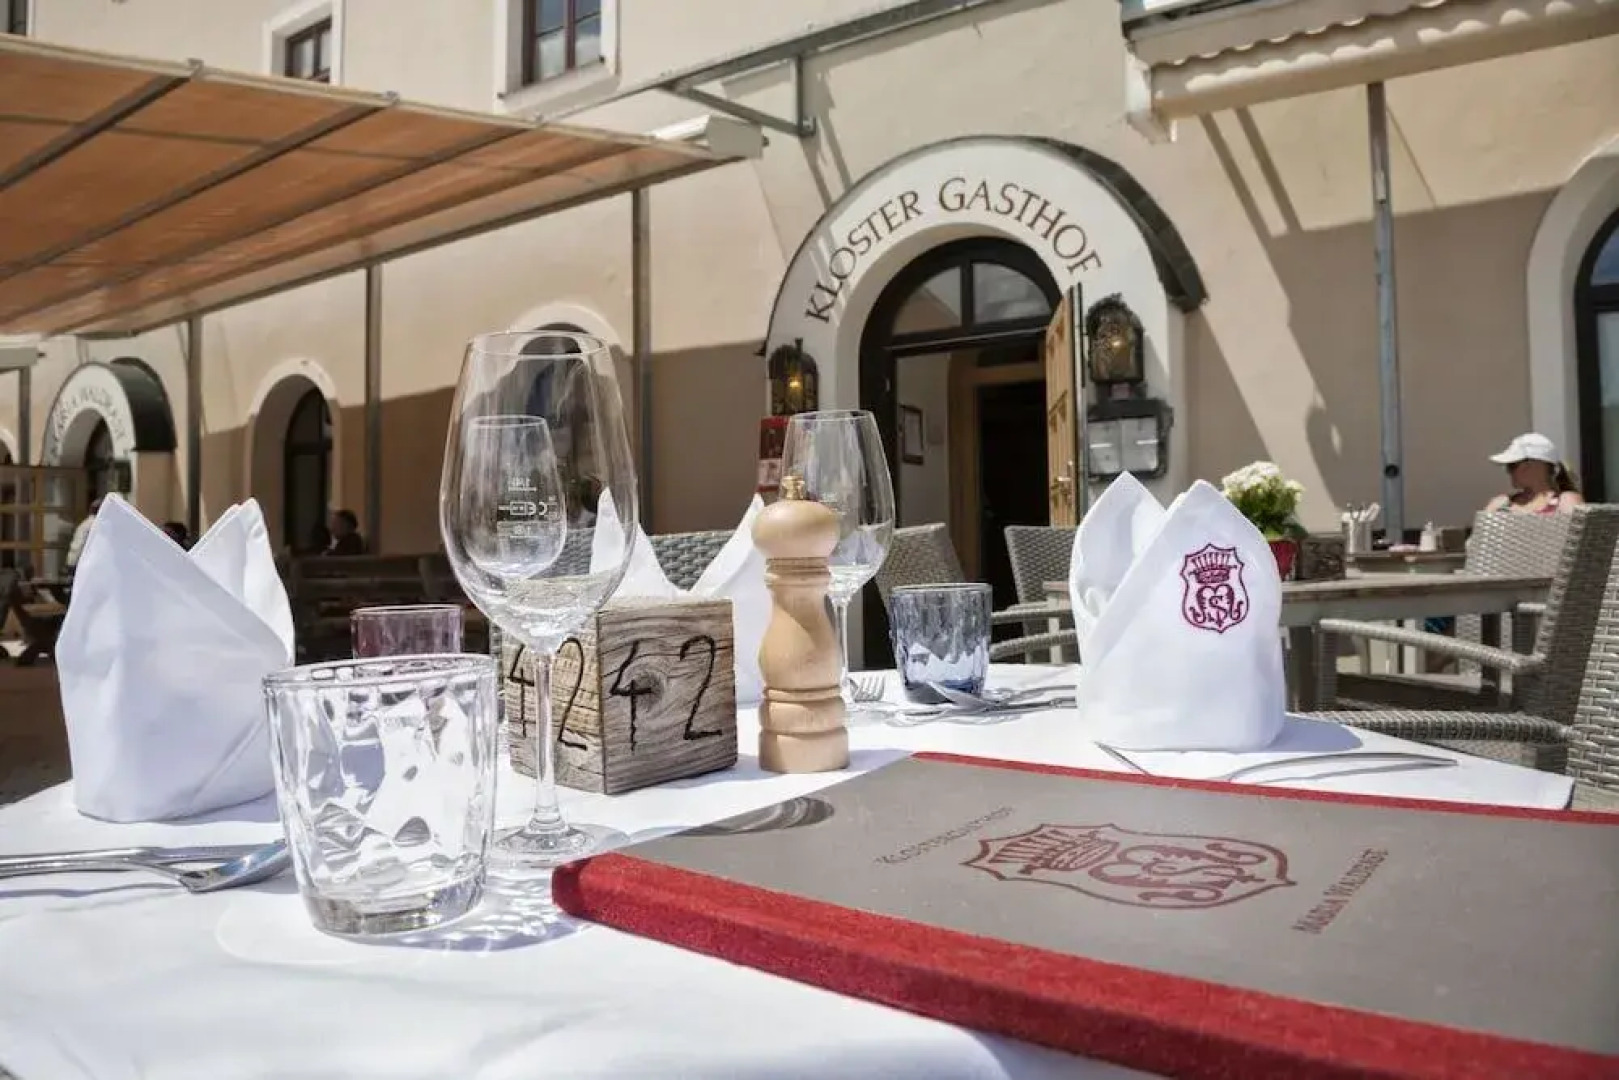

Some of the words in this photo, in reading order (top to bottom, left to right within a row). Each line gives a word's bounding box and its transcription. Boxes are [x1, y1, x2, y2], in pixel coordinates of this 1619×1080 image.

[804, 189, 924, 324] KLOSTER
[938, 176, 1103, 275] GASTHOF
[506, 637, 588, 751] 42
[609, 634, 723, 753] 42
